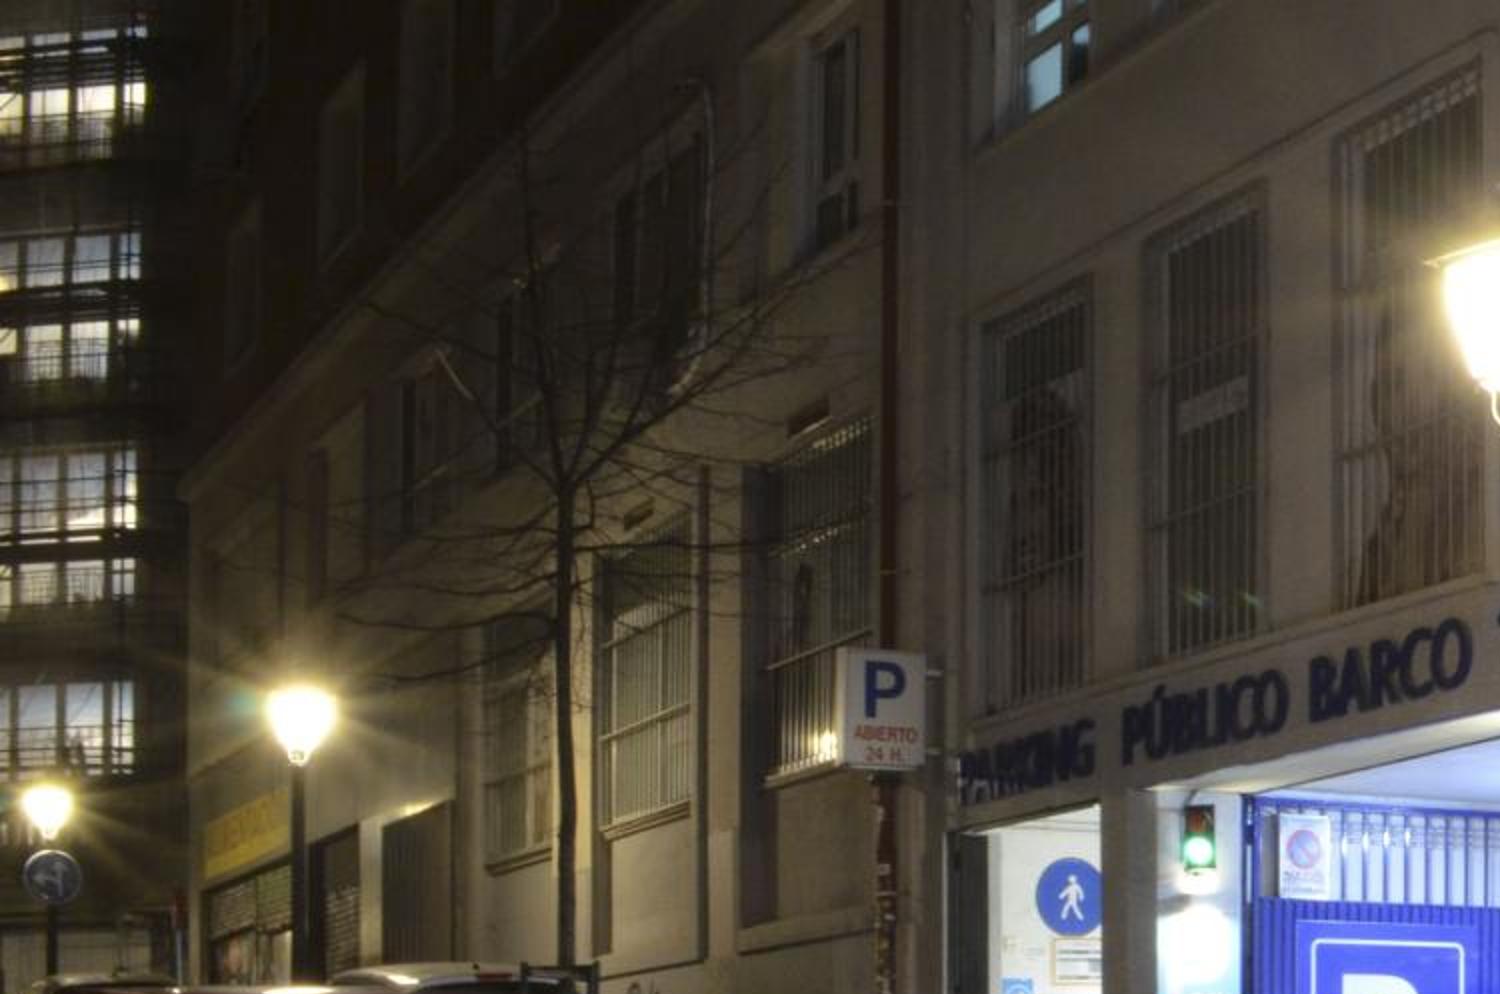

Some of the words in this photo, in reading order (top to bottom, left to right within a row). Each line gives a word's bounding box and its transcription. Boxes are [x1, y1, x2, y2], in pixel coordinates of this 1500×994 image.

[865, 660, 905, 718] P
[1121, 669, 1288, 766] PÚBLICO
[1309, 617, 1472, 723] BARCO
[855, 724, 918, 744] ABIERTO
